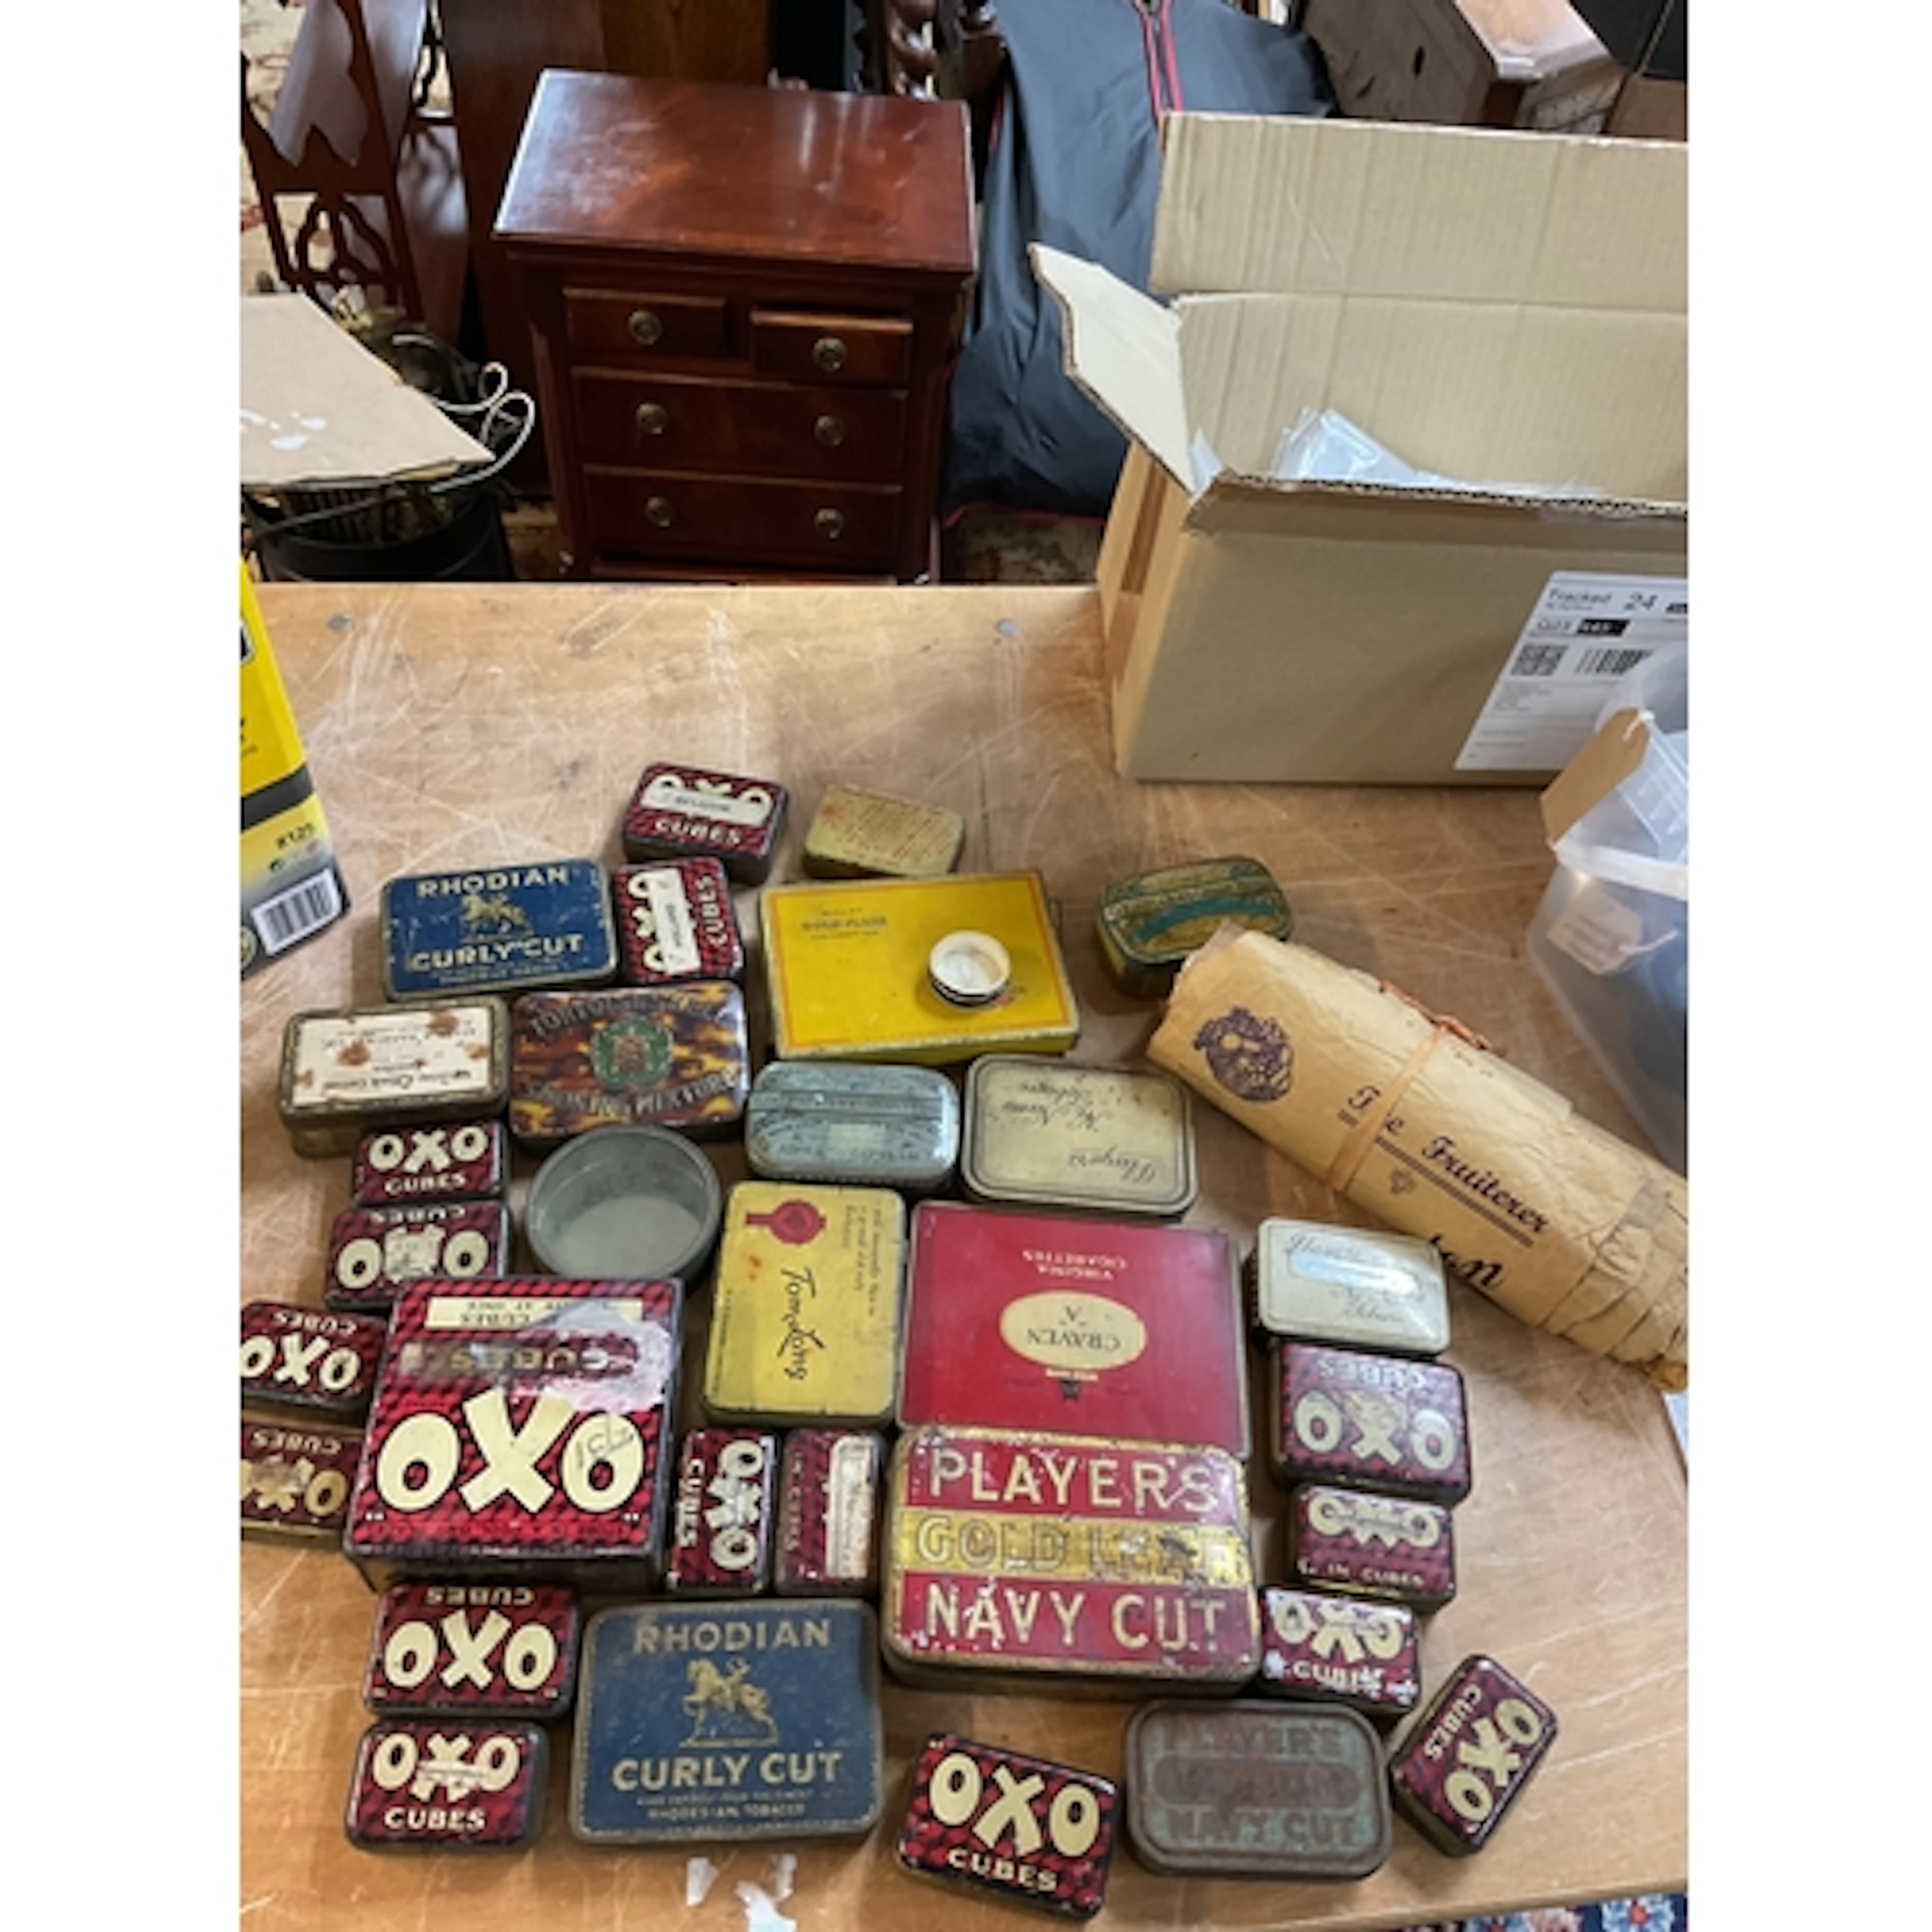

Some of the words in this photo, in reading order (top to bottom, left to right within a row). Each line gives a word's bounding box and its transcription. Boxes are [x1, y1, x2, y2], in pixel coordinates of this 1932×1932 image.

[654, 816, 742, 846] CUBES
[417, 866, 569, 899] RHODIAN
[693, 873, 728, 947] CUBES
[409, 939, 510, 973] CURLY
[524, 933, 585, 958] CUT
[368, 1125, 489, 1173] OXO
[1346, 1084, 1406, 1135] Te
[1420, 1134, 1551, 1235] Fruiterer
[384, 1173, 466, 1195] CUBES
[780, 1266, 819, 1324] Tom
[272, 1311, 359, 1336] CUBES
[1026, 1327, 1121, 1352] CRAVEN
[239, 1333, 361, 1391] OXO
[449, 1347, 611, 1373] CUBES
[776, 1324, 828, 1381] Long
[1317, 1358, 1428, 1389] CUBES
[252, 1427, 343, 1456] CUBES
[376, 1386, 645, 1514] OXO
[1295, 1389, 1457, 1471] OXO
[240, 1458, 348, 1518] XO
[679, 1459, 702, 1548] CUBES
[915, 1514, 1066, 1571] GOLD
[426, 1586, 536, 1606] CUBES
[1361, 1567, 1424, 1586] CUBES
[633, 1620, 832, 1654] RHODIAN
[927, 1582, 1086, 1645] NAVY
[1111, 1593, 1227, 1651] CUT
[384, 1608, 558, 1691] OXO
[1422, 1683, 1482, 1760] CUBES
[373, 1732, 520, 1803] OXO
[611, 1755, 749, 1792] CURLY
[759, 1753, 843, 1785] CUT
[1445, 1698, 1543, 1823] OXO
[384, 1806, 486, 1831] CUBES
[928, 1751, 1100, 1858] OXO
[1282, 1810, 1356, 1846] CUT
[946, 1848, 1059, 1895] CUBES
